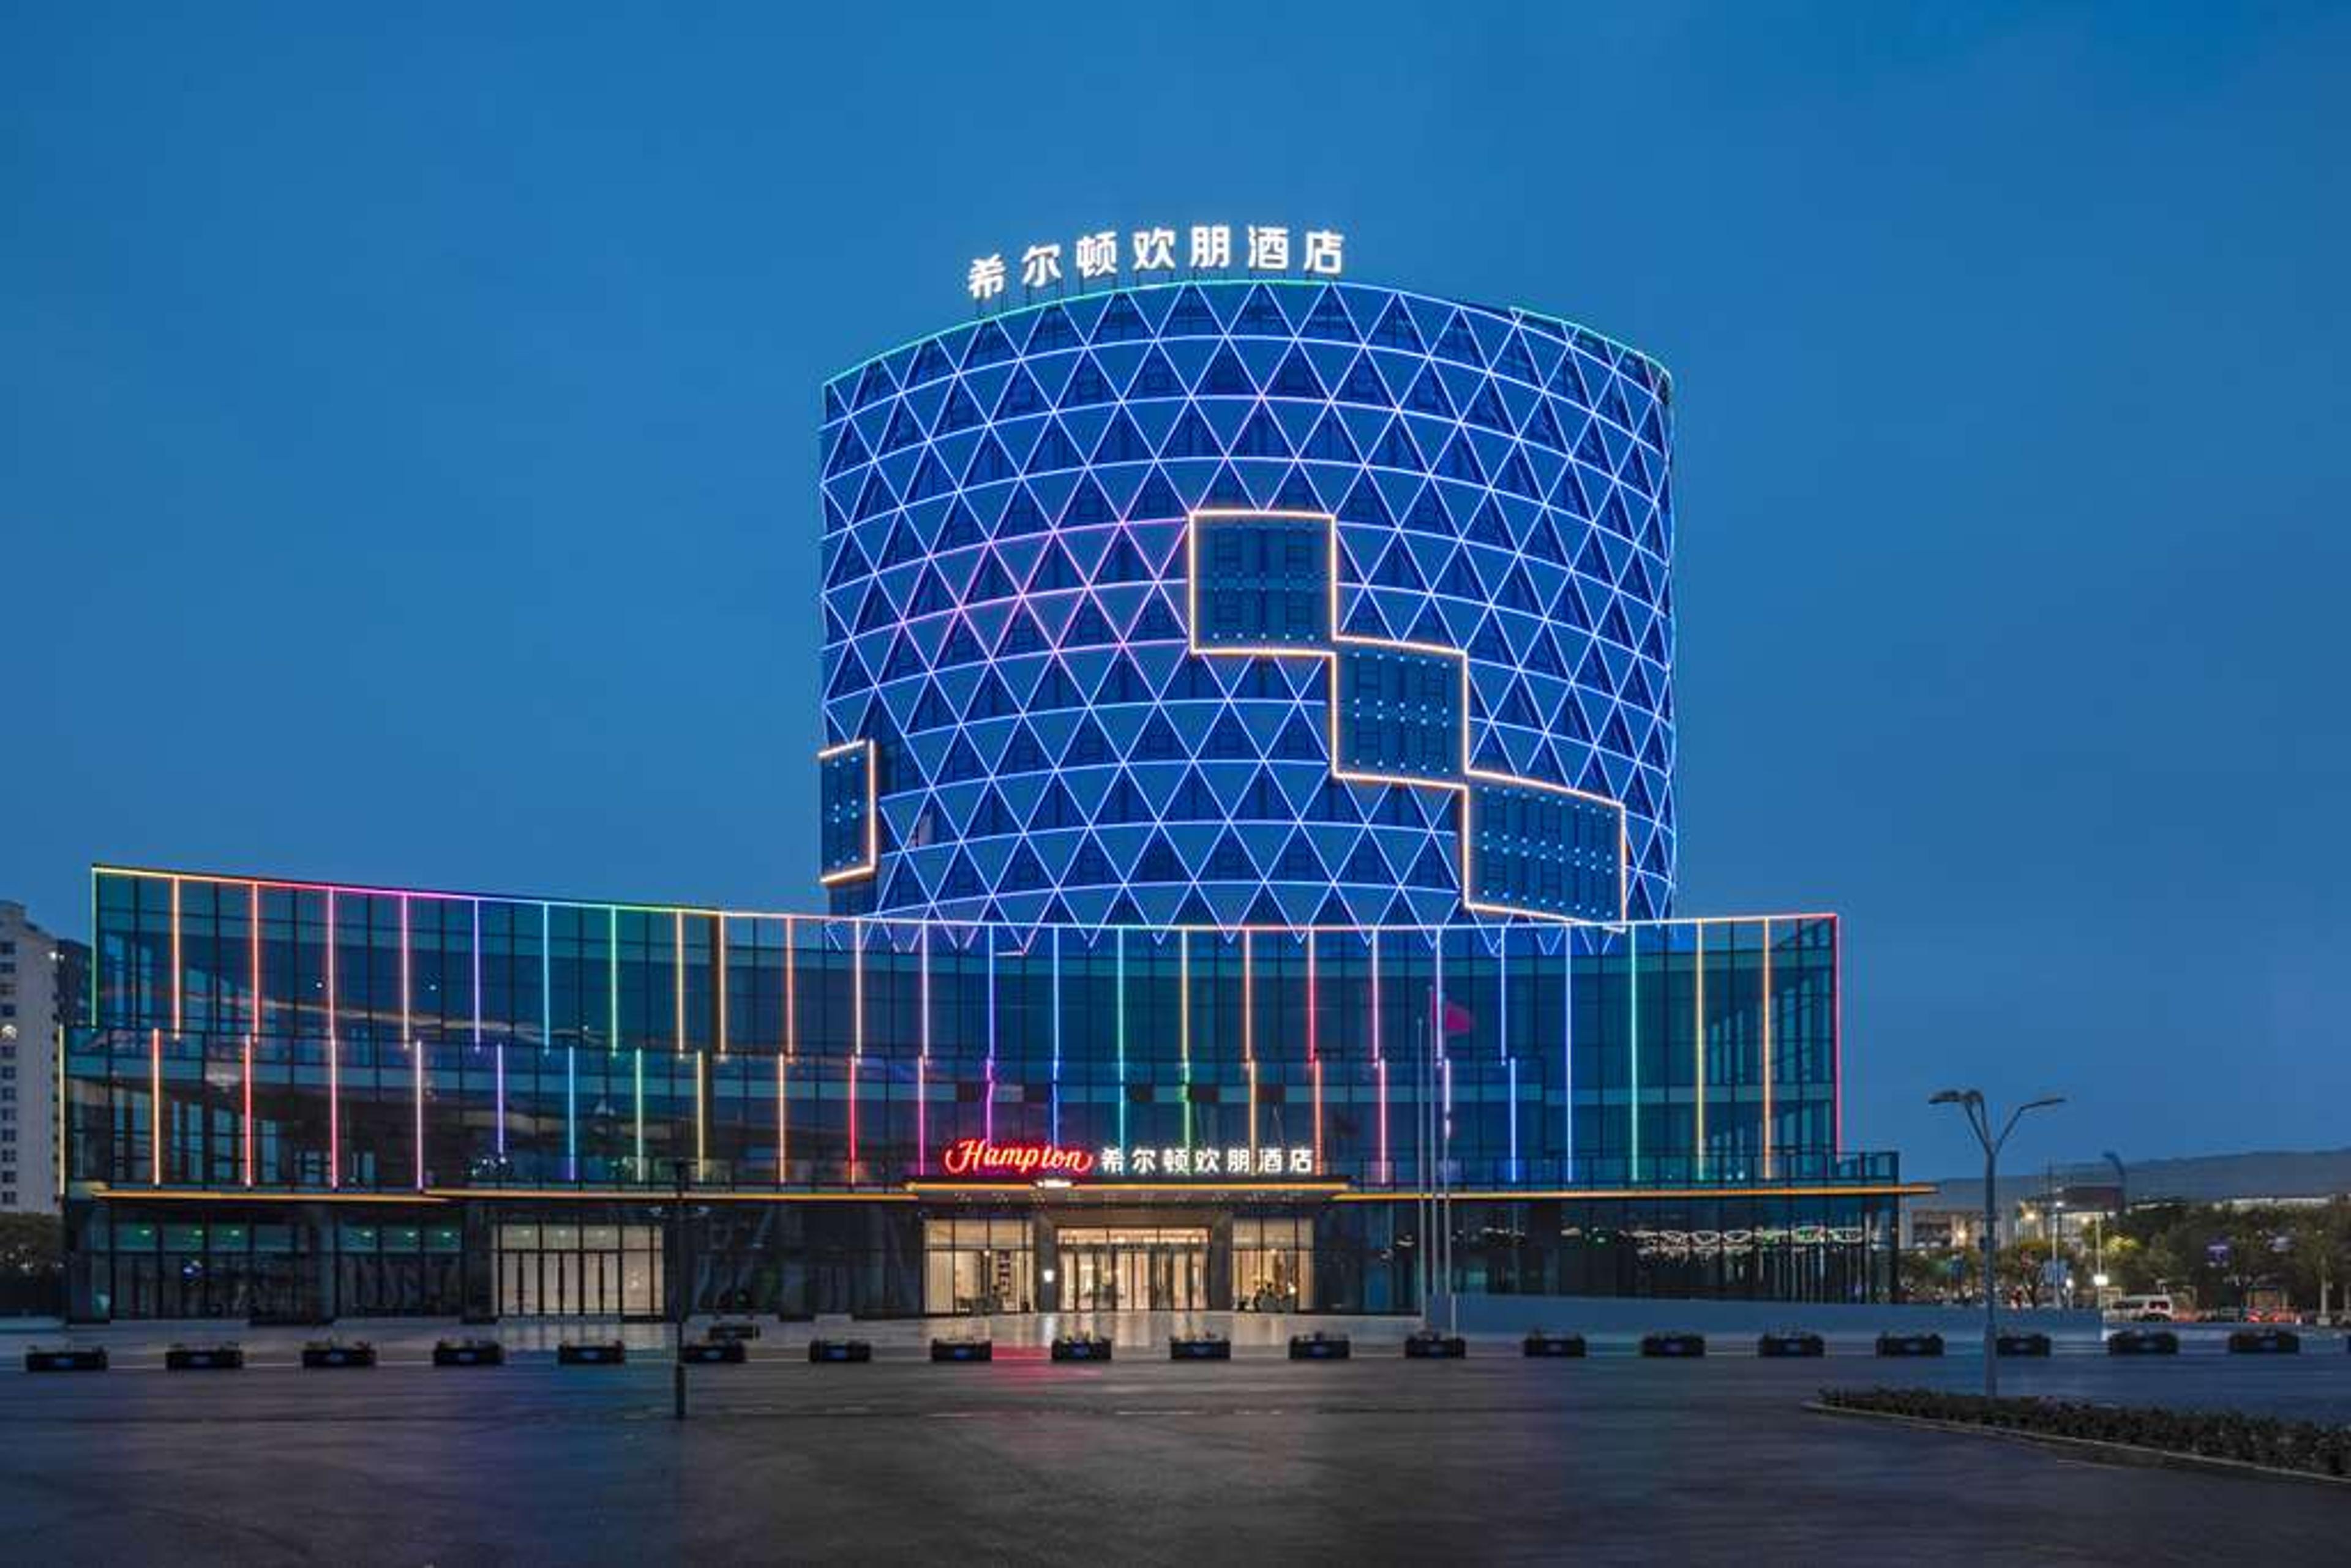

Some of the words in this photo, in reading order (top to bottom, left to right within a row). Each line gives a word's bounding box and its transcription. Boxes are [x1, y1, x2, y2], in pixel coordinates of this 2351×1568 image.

[968, 225, 1343, 299] 希尔顿欢朋酒店
[945, 1139, 1093, 1174] Hampton
[1101, 1146, 1314, 1174] 希尔顿欢朋酒店
